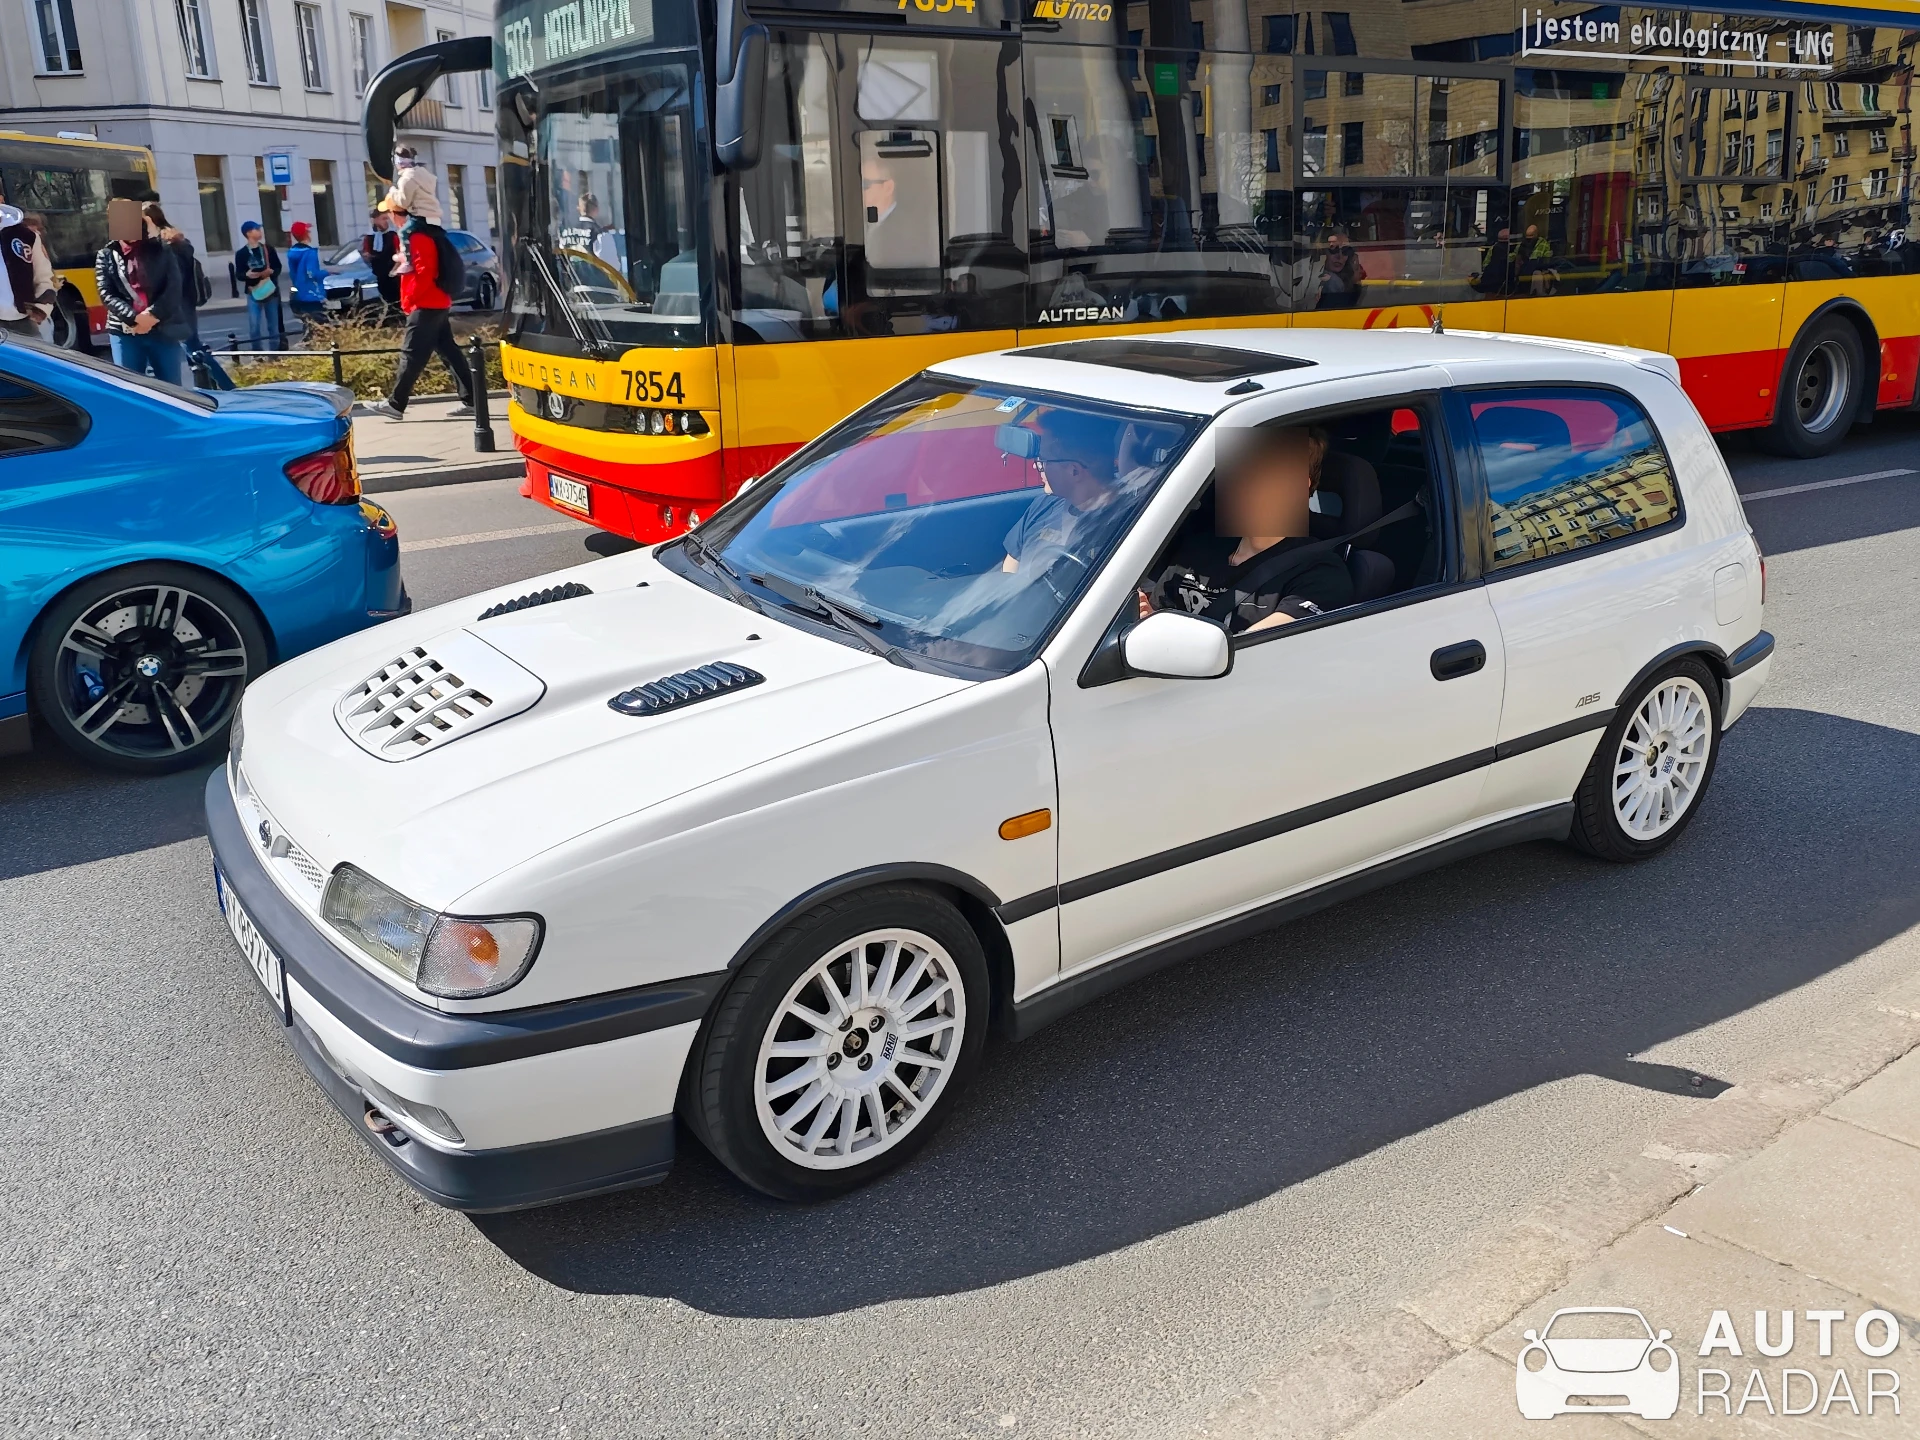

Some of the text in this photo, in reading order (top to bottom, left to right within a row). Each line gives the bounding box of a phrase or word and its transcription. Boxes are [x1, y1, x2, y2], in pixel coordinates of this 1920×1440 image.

[1068, 3, 1113, 22] mza
[504, 16, 535, 79] 503
[543, 0, 600, 61] NATOLIN
[1534, 9, 1620, 46] jestem
[1630, 17, 1769, 60] ekologiczny
[1794, 29, 1835, 58] LNG
[1037, 305, 1124, 323] AUTOSAN
[509, 358, 597, 392] AUTOSAN
[620, 369, 686, 405] 7854
[1574, 691, 1601, 709] ABS
[882, 1033, 898, 1061] BRAID
